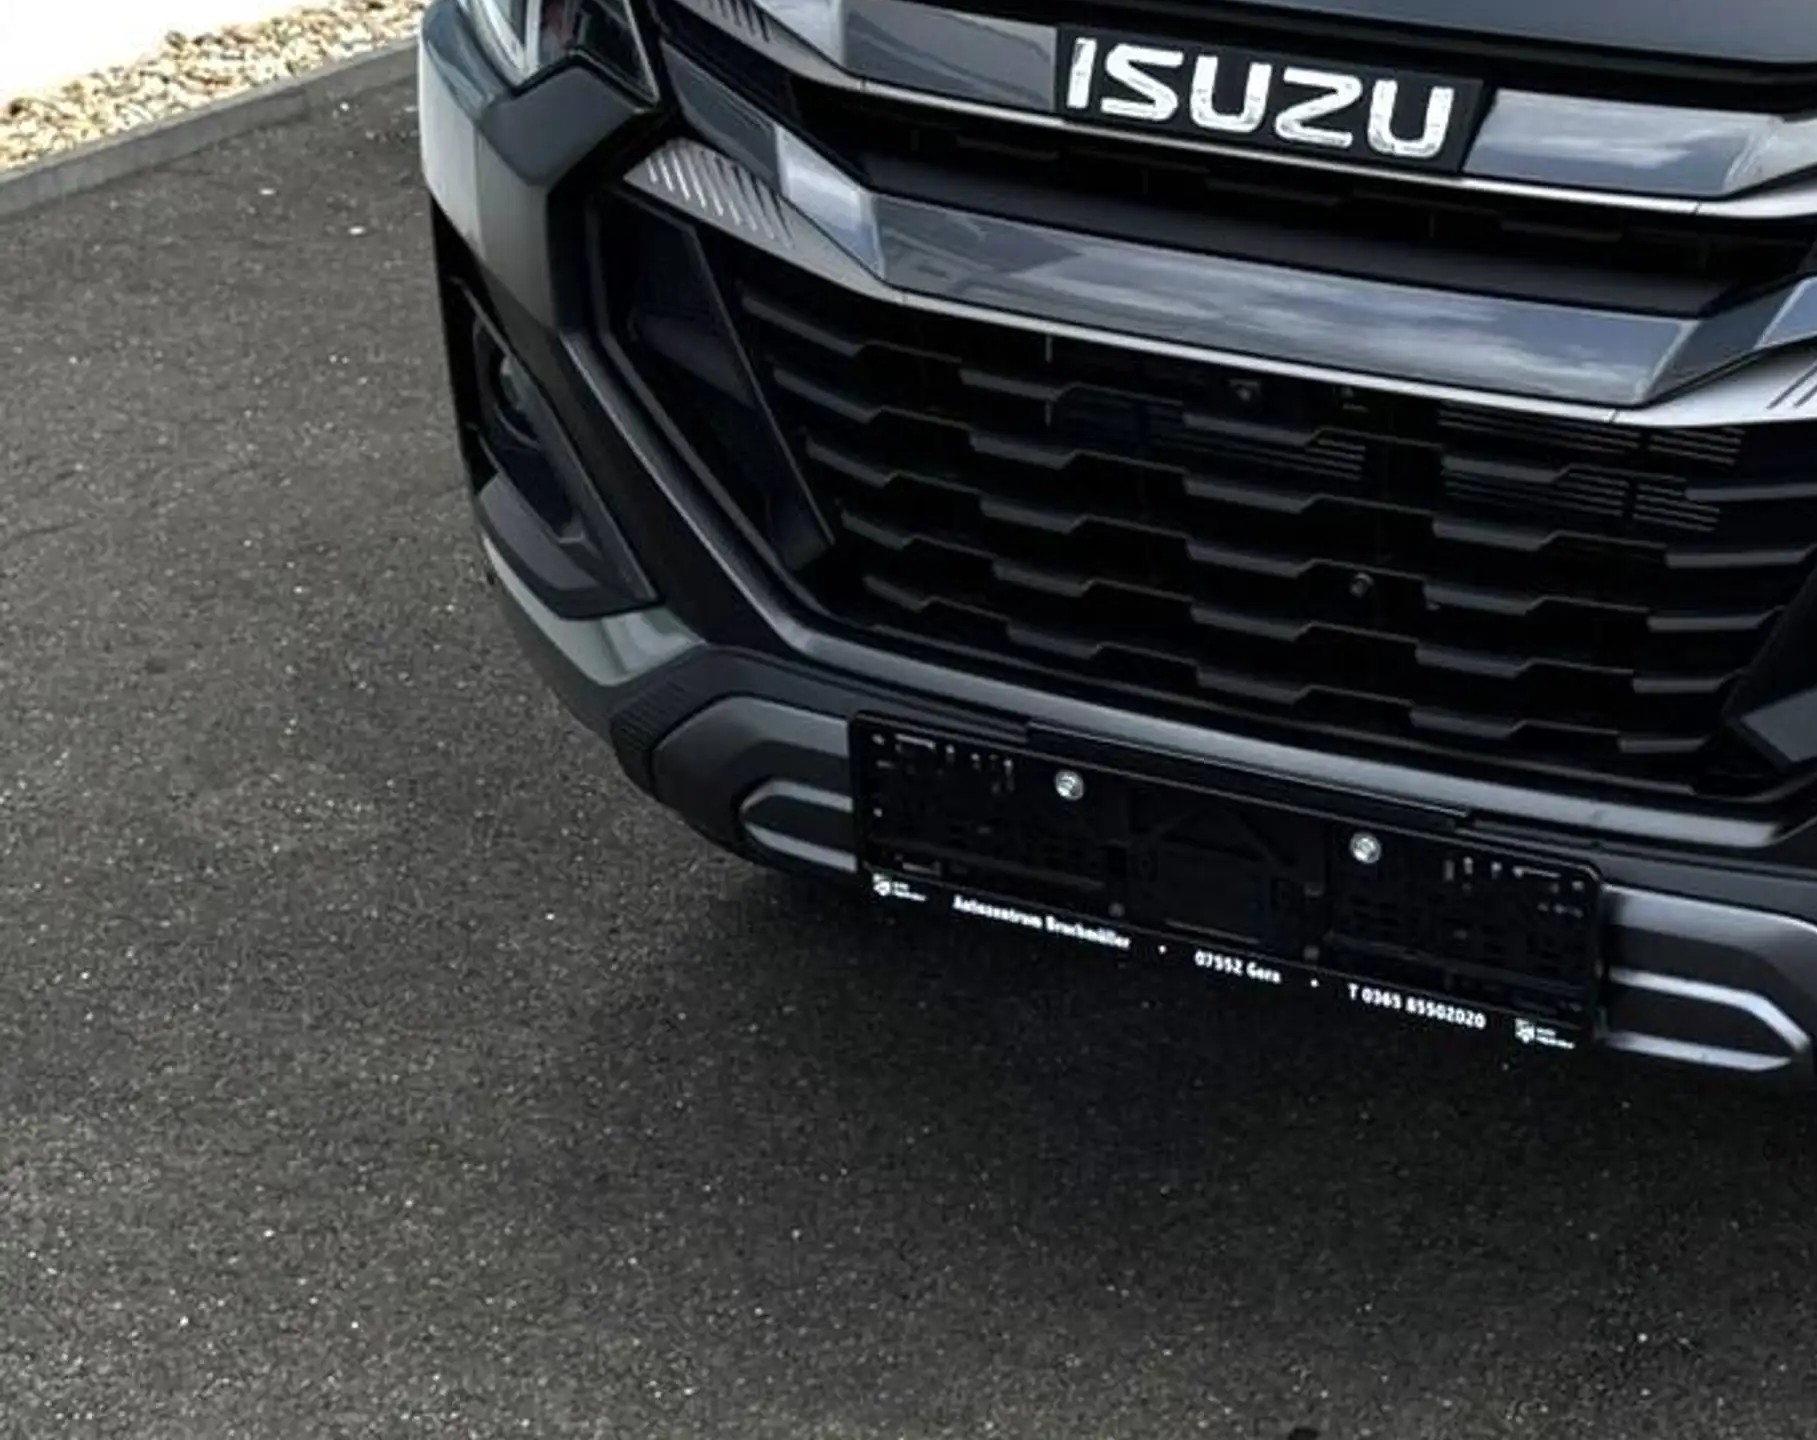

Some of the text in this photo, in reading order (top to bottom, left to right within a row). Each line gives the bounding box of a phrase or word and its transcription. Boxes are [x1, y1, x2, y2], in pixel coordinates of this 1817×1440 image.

[1066, 37, 1455, 158] ISUZU
[1246, 961, 1281, 984] Gera
[1348, 983, 1359, 1000] T
